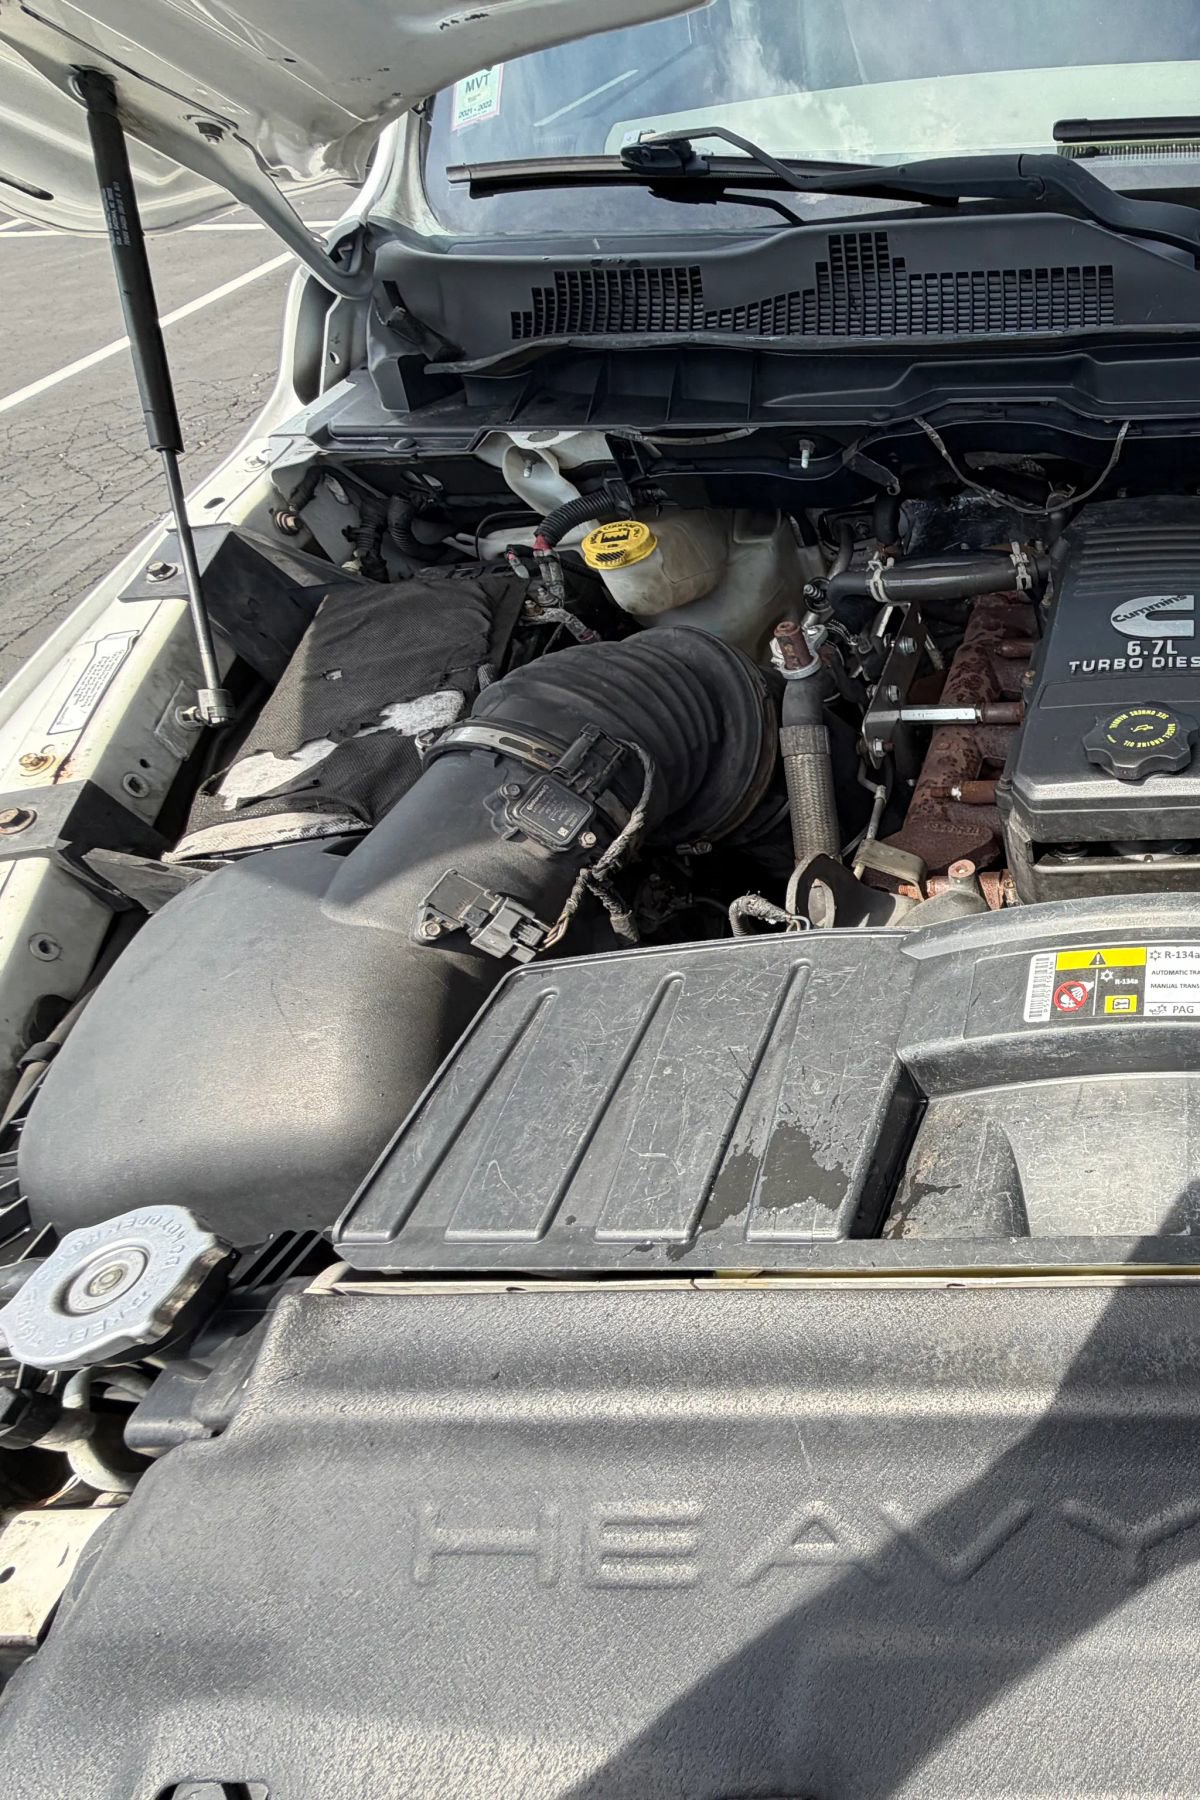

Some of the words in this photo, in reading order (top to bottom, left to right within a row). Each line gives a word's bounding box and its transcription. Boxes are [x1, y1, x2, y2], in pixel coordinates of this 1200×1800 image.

[465, 73, 491, 93] MVT
[1112, 594, 1187, 623] Cummins
[1127, 640, 1178, 656] 6.7L
[1069, 657, 1143, 673] TURBO
[1137, 737, 1165, 748] ENGINE
[1164, 951, 1200, 959] R-134a
[1172, 1005, 1194, 1014] PAG
